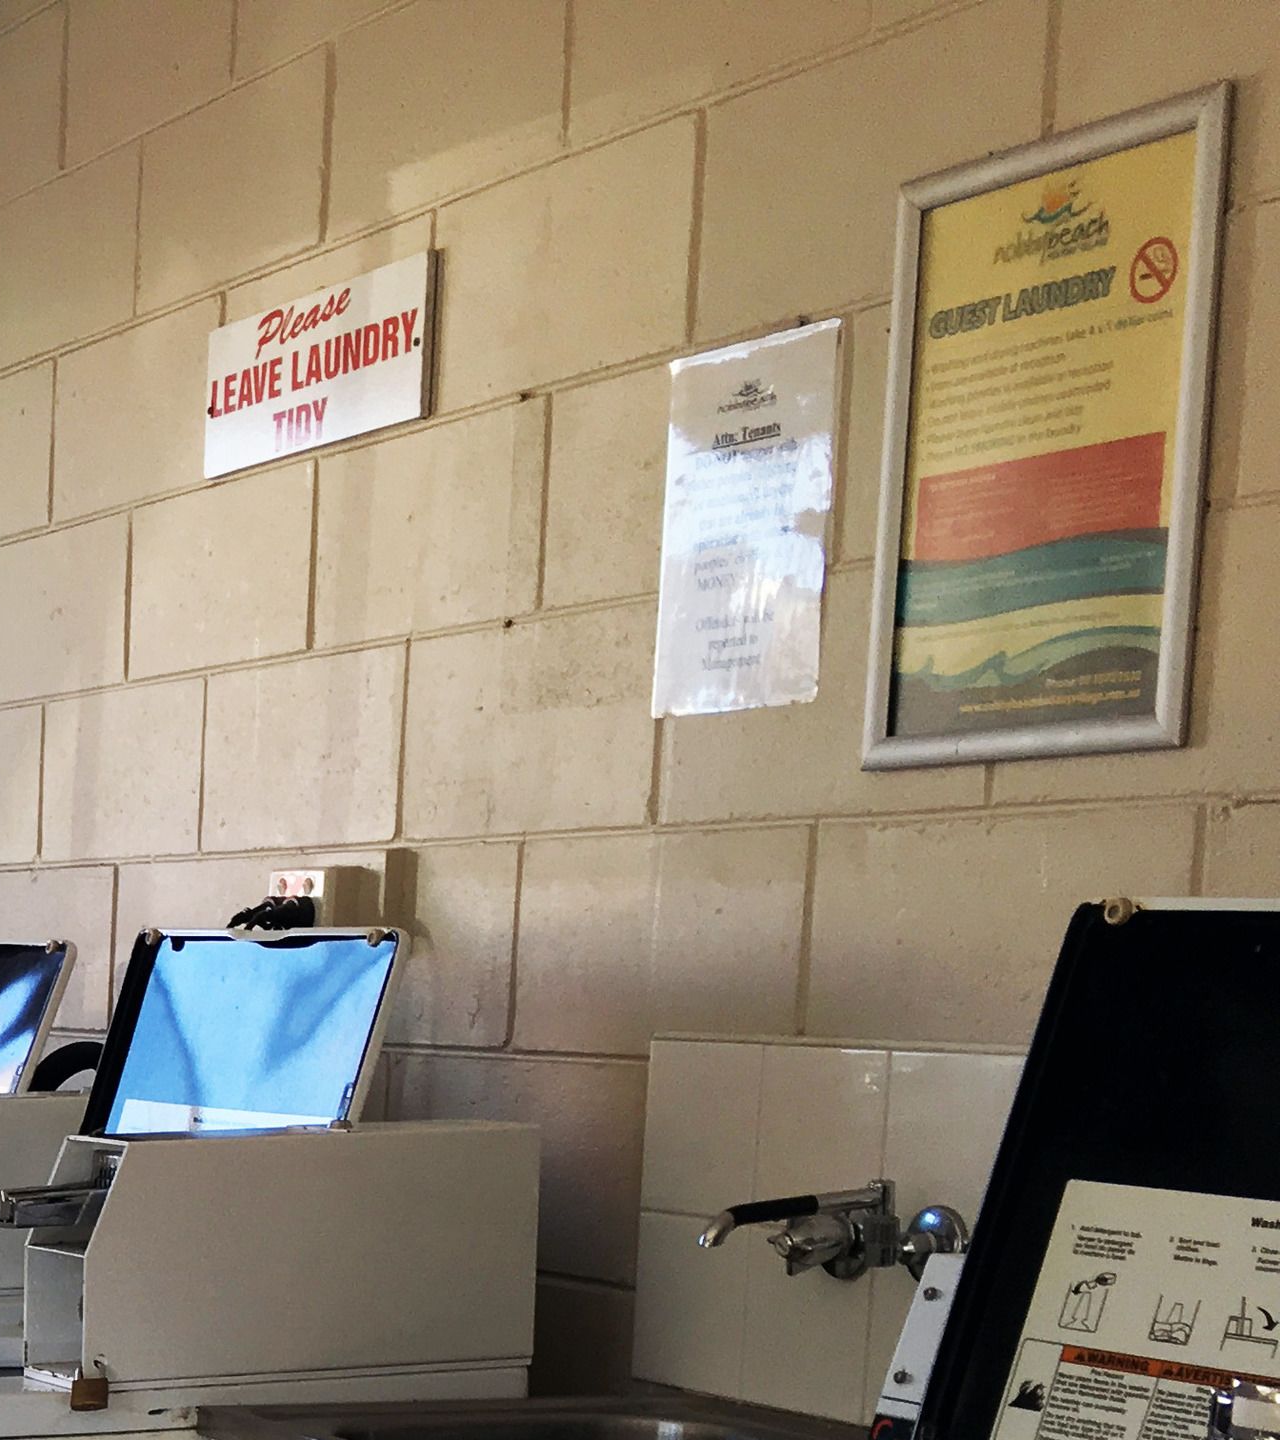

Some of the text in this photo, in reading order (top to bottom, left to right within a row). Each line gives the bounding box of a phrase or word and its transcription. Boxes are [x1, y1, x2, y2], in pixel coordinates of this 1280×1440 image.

[255, 287, 352, 360] Please
[928, 265, 1118, 341] GUEST LAUNDRY
[211, 308, 418, 419] LEAVE LAUNDRY
[273, 397, 329, 452] TIDY
[713, 423, 782, 447] Attn: Tenants
[1087, 1350, 1150, 1372] WARNING
